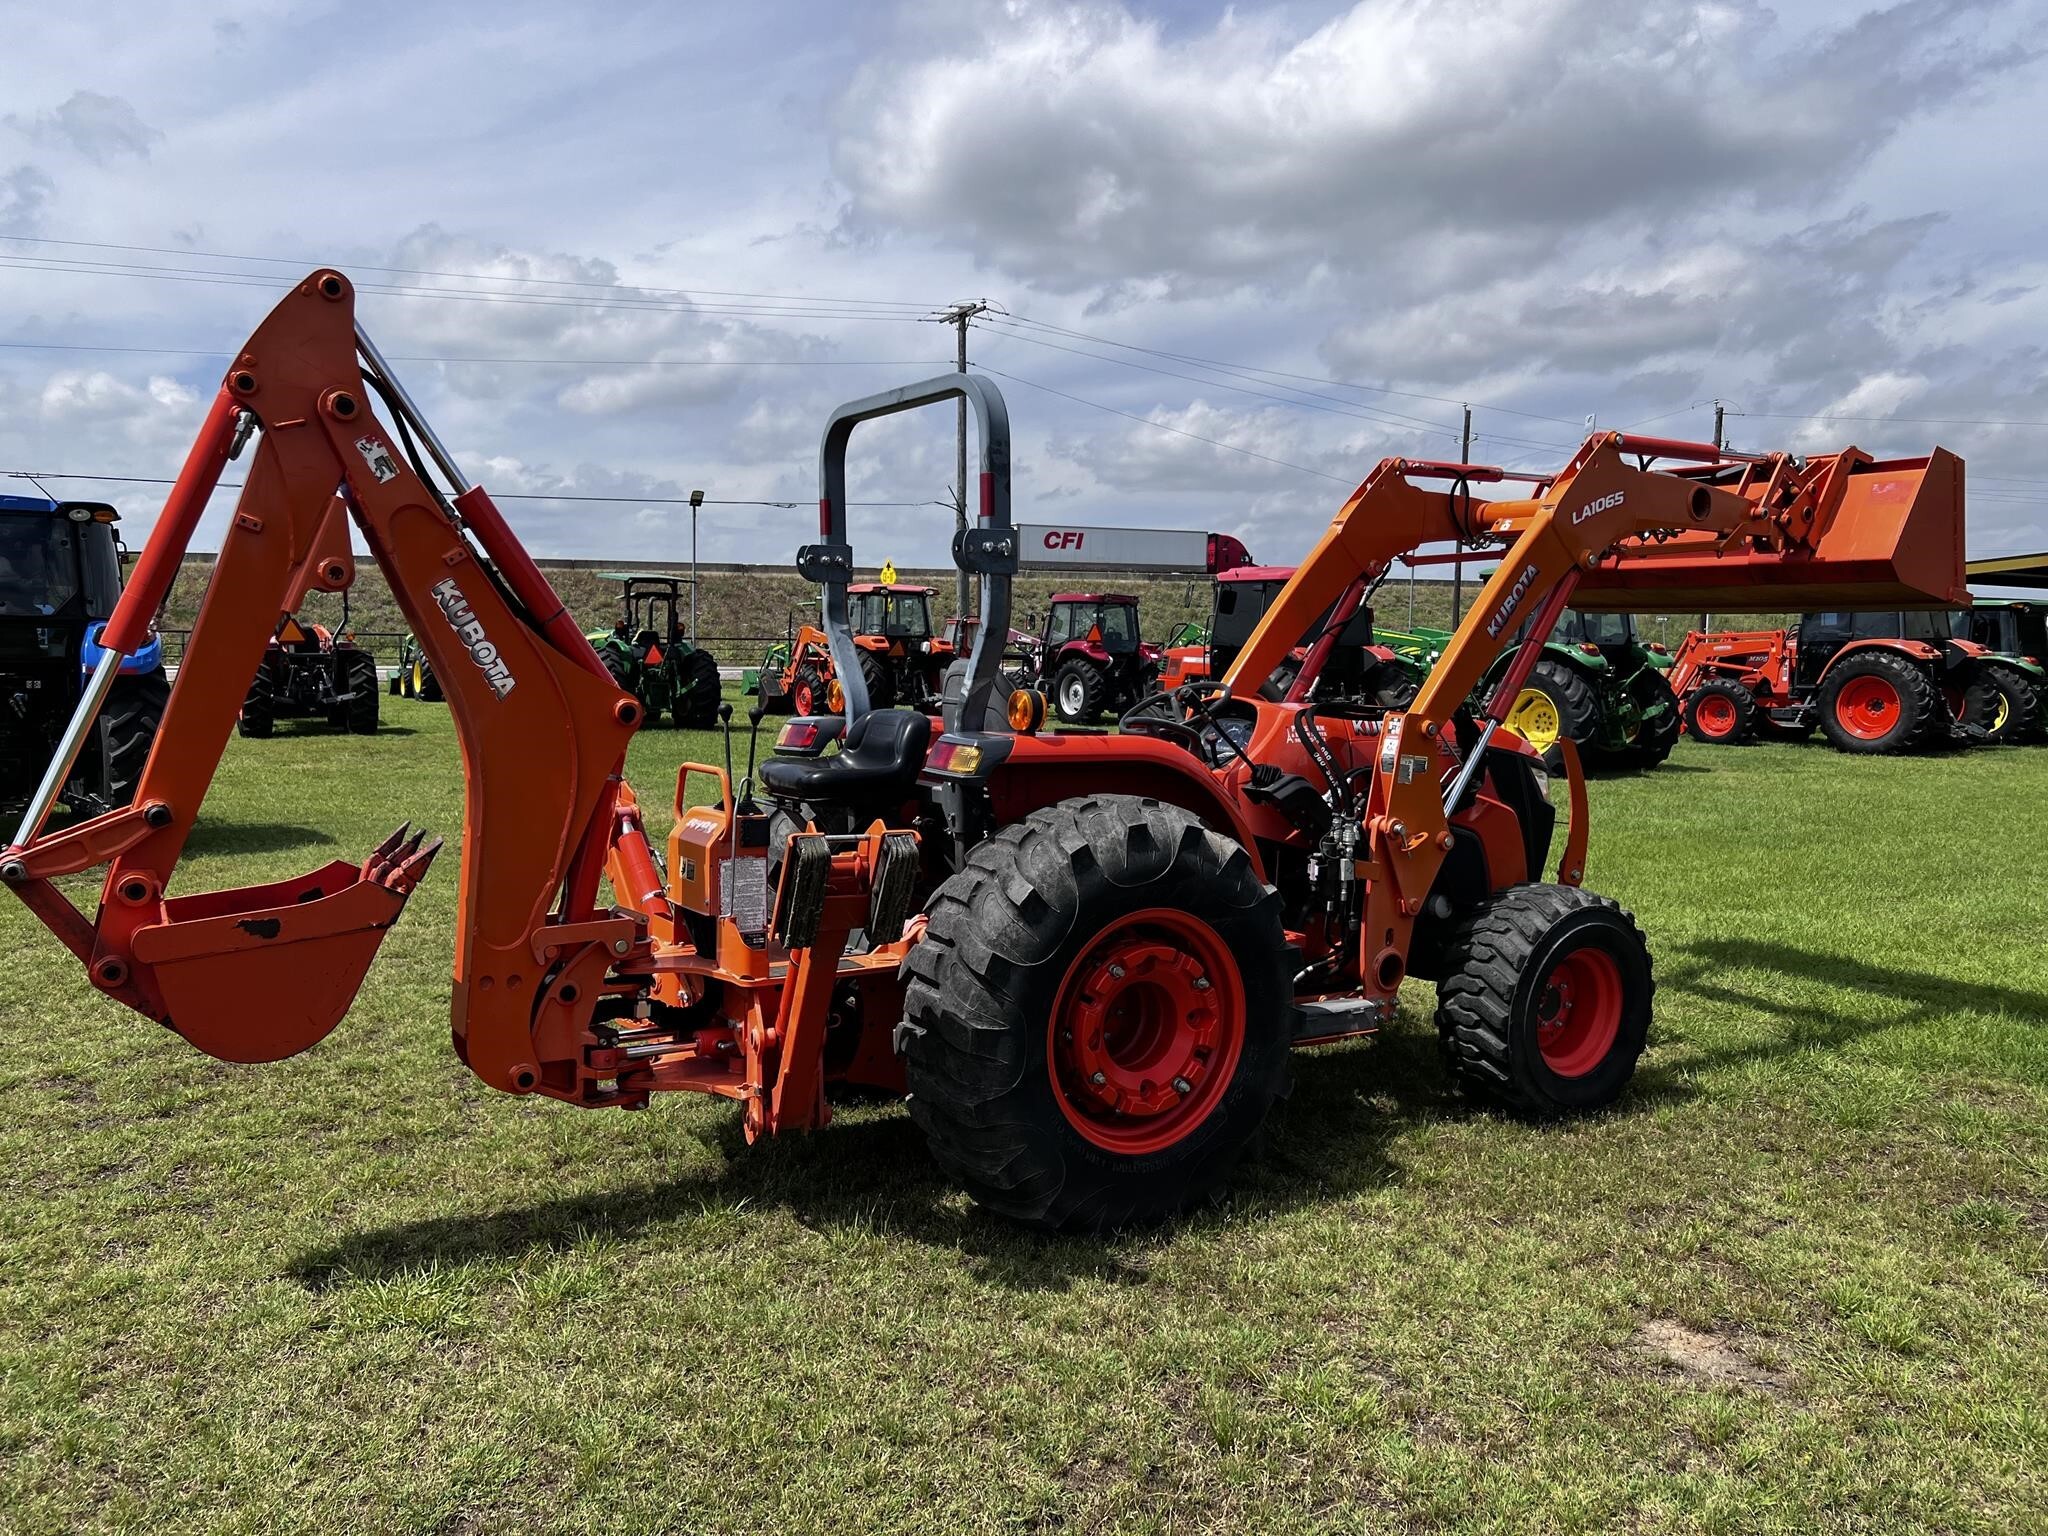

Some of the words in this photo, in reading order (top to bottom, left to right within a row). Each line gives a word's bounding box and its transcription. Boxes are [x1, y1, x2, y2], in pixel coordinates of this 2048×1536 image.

[1571, 491, 1625, 525] LA1065
[1043, 531, 1084, 550] CFI
[1487, 564, 1540, 640] KUBOTA
[430, 577, 516, 701] KUBOTA
